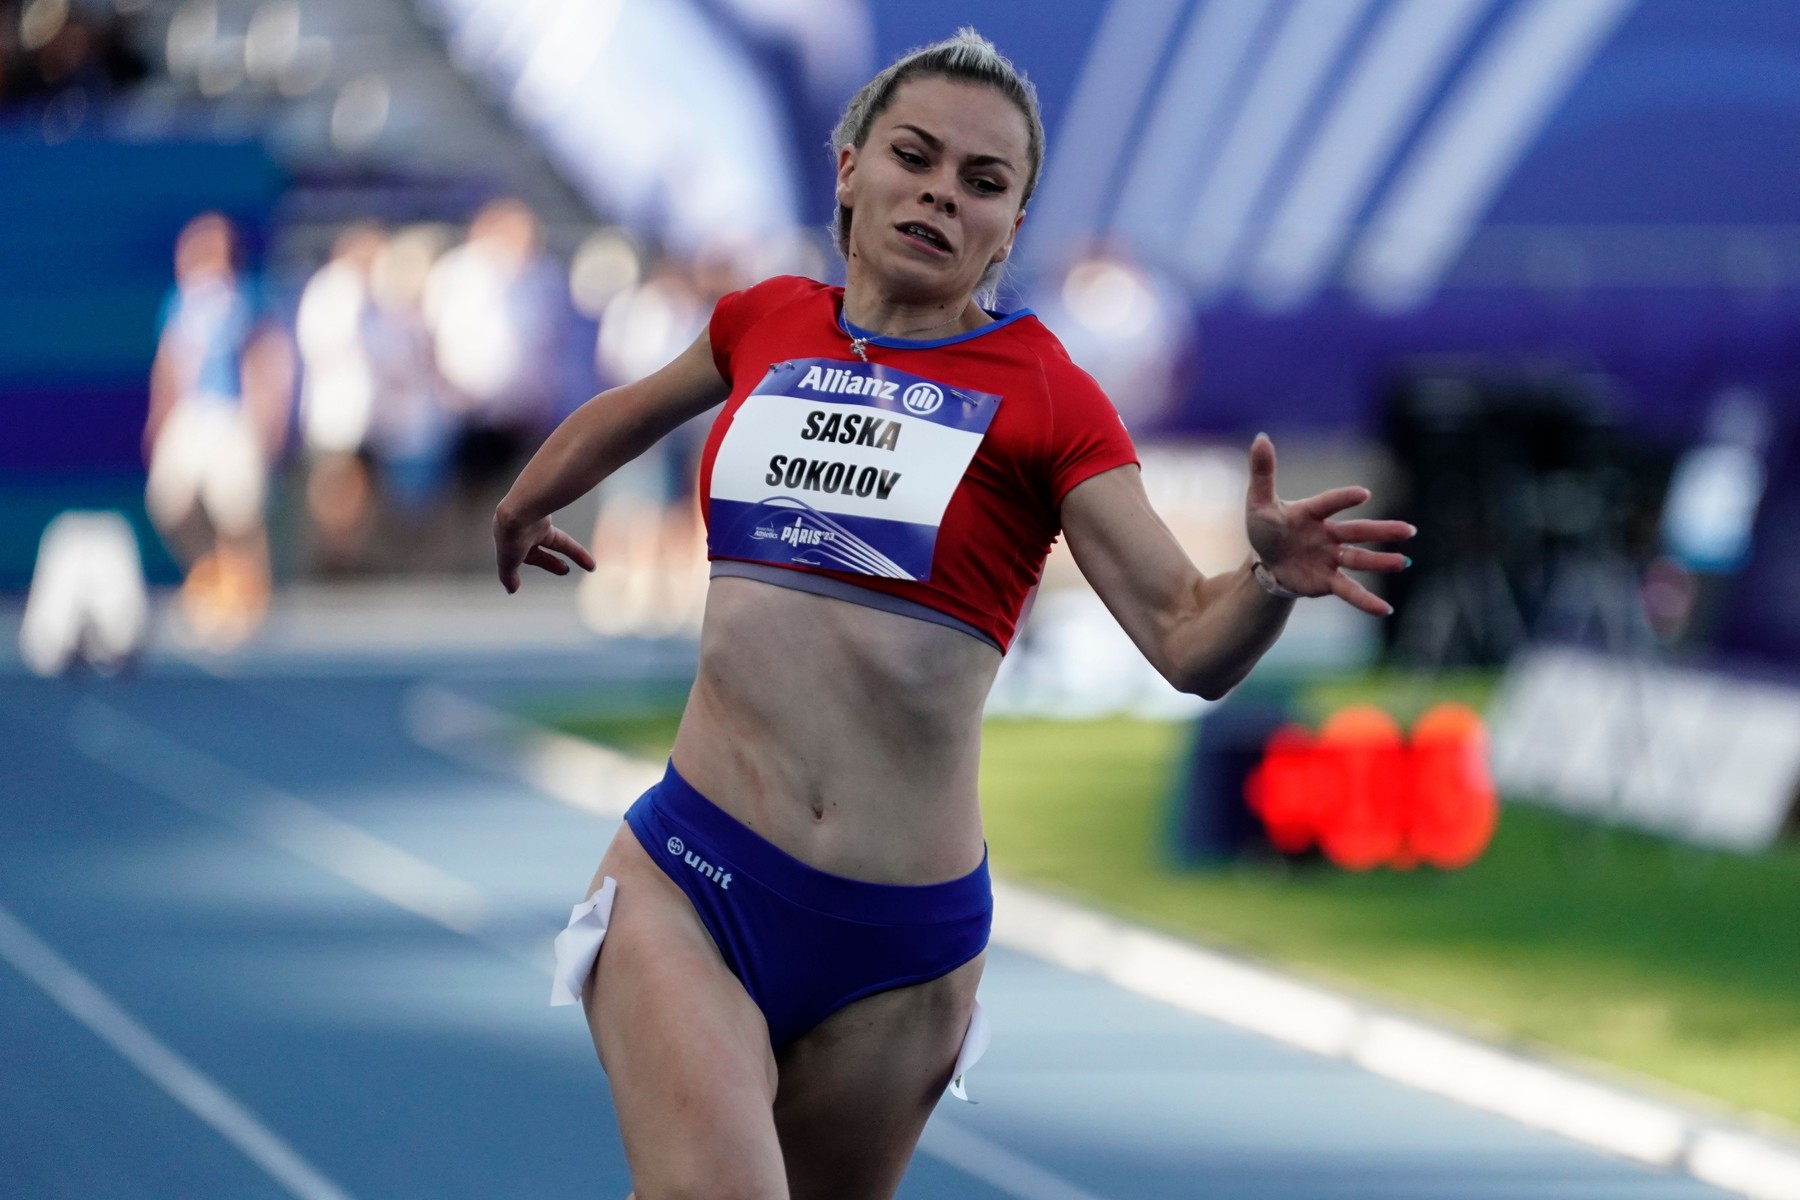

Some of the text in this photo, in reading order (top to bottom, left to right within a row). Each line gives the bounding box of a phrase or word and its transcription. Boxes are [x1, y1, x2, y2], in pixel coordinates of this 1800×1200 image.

[798, 366, 899, 400] Allianz
[800, 411, 902, 451] SASKA
[765, 455, 901, 500] SOKOLOV
[684, 850, 732, 890] unit
